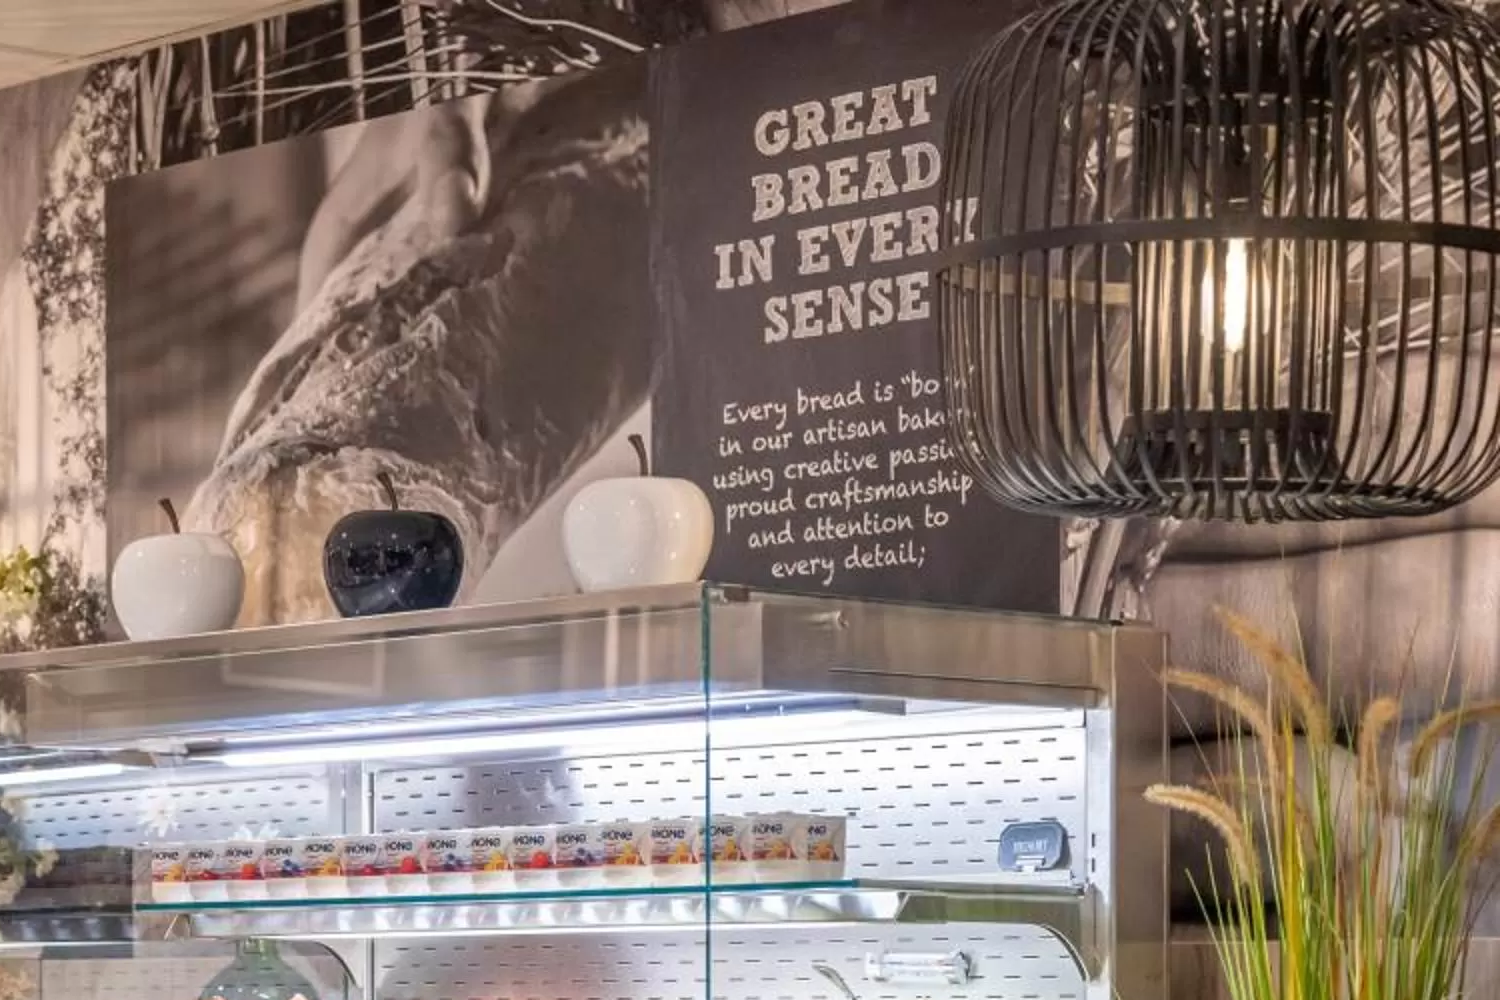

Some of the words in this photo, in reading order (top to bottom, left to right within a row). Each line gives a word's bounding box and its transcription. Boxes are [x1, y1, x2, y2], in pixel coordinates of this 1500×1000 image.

[754, 75, 937, 156] GREAT
[752, 142, 942, 222] BREAD
[714, 235, 775, 289] IN
[797, 197, 979, 275] EVERY
[764, 271, 930, 344] SENSE
[723, 403, 787, 430] Every
[797, 381, 863, 416] bread
[874, 379, 894, 402] is
[719, 436, 742, 457] in
[752, 431, 793, 452] our
[803, 419, 886, 444] artisan
[713, 466, 774, 492] using
[784, 451, 879, 481] creative
[726, 491, 795, 533] proud
[805, 470, 973, 513] craftsmanship
[748, 519, 795, 549] and
[803, 510, 913, 543] attention
[924, 505, 950, 529] to
[771, 555, 835, 585] every
[844, 540, 926, 570] detail;
